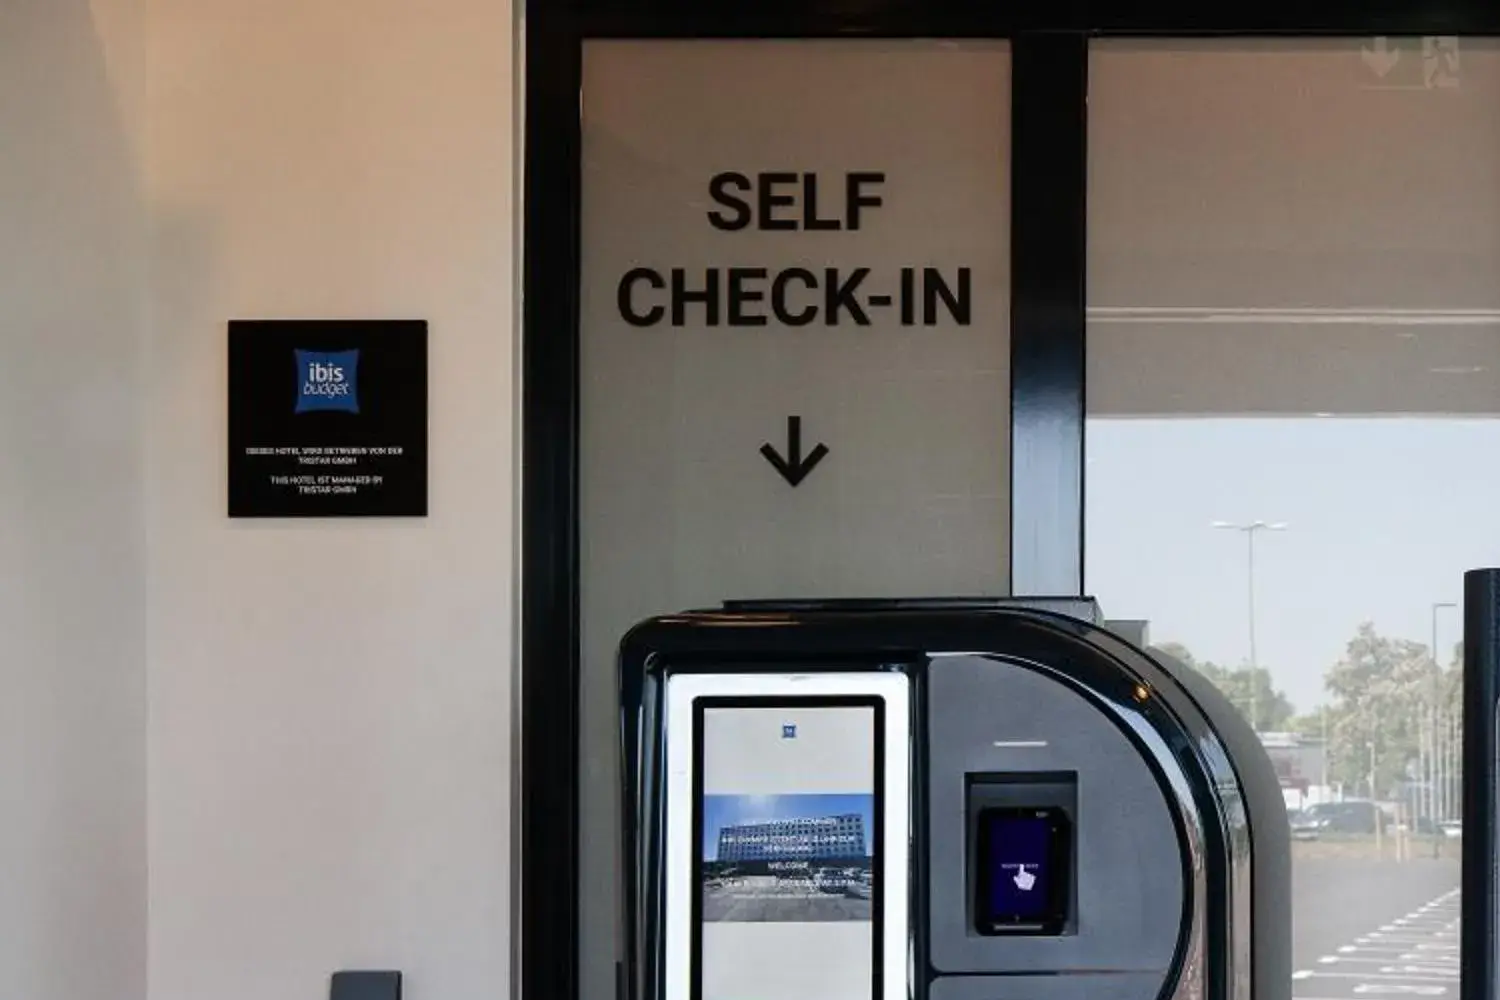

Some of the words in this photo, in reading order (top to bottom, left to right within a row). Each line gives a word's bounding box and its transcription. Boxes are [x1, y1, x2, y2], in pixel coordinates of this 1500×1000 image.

[707, 172, 885, 231] SELF
[617, 267, 972, 327] CHECK-IN
[309, 363, 344, 382] ibis
[303, 381, 349, 399] budget
[270, 475, 289, 485] THIS
[290, 475, 316, 485] HOTEL
[767, 861, 809, 870] WELCOME
